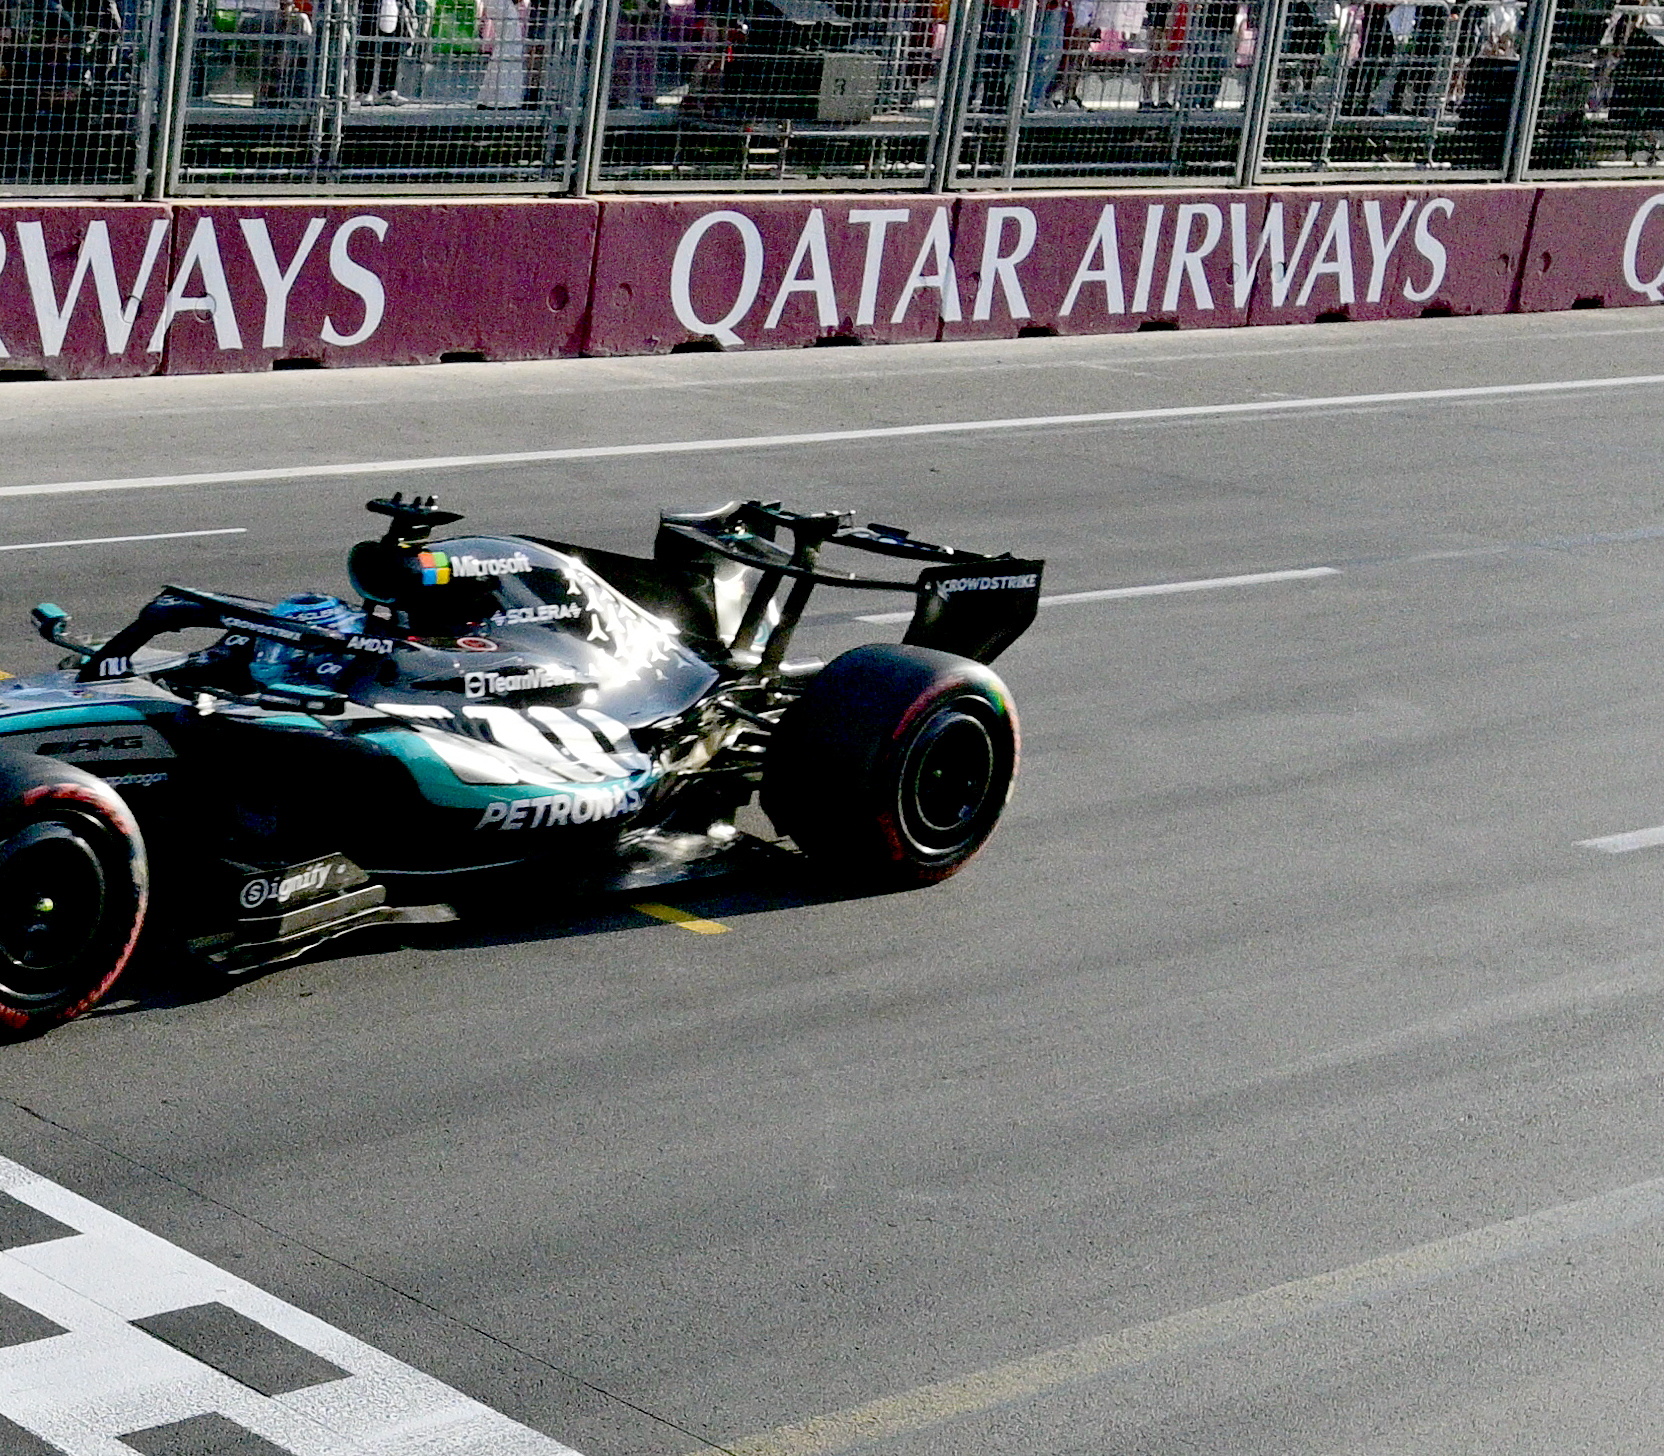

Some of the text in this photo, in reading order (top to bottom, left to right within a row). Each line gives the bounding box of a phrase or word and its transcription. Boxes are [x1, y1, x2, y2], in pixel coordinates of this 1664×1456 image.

[671, 197, 1455, 346] QATAR AIRWAYS
[452, 551, 533, 578] Microsoft
[940, 572, 1038, 597] CROWDSTRIKE
[347, 635, 382, 653] AMD
[474, 785, 646, 831] PETRONAS
